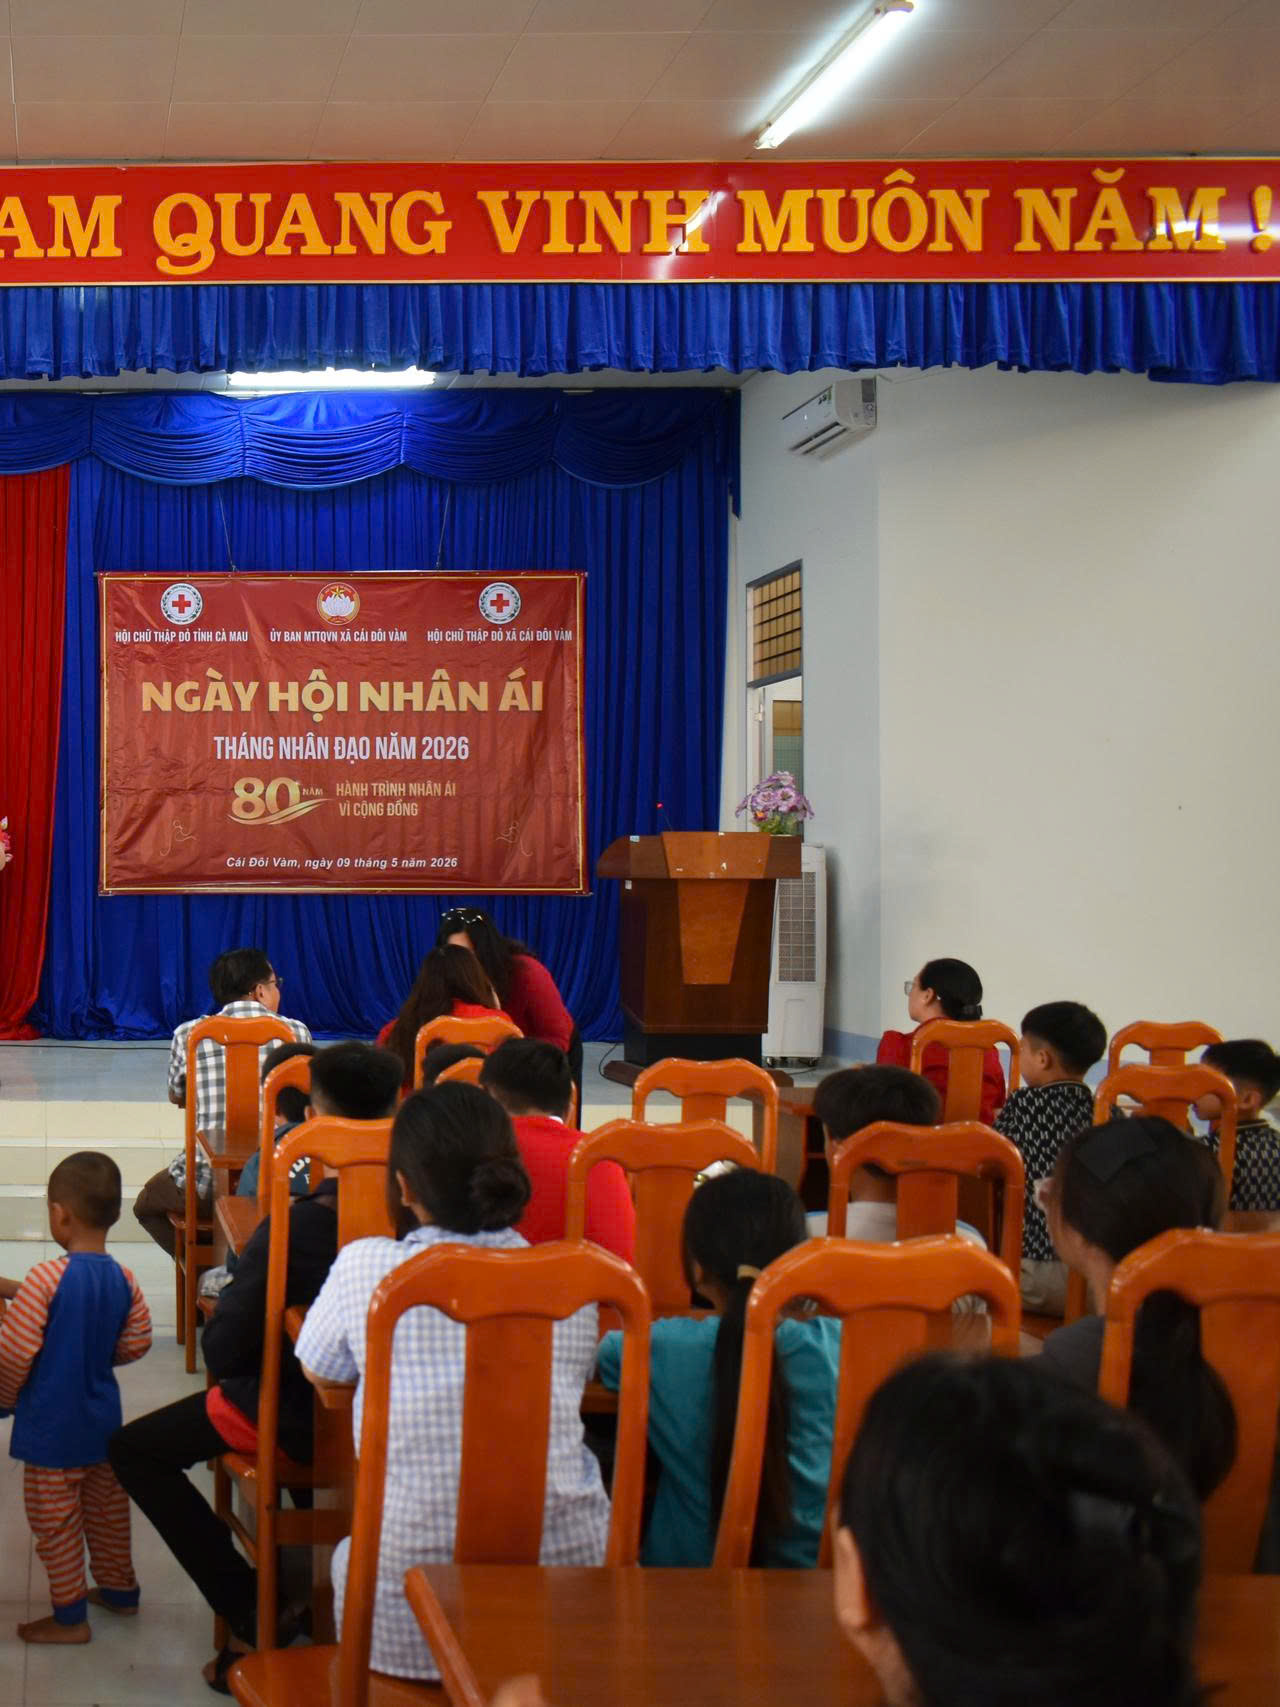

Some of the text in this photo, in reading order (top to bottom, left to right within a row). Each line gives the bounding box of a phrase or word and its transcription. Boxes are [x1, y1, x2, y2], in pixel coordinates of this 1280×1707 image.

[153, 191, 453, 275] QUANG
[477, 190, 710, 255] VINH
[735, 168, 990, 253] MUÔN
[1013, 167, 1227, 252] NĂM
[115, 627, 248, 644] HỘI CHỮ THẬP ĐỎ TỈNH CÀ MAU
[270, 627, 407, 643] ỦY BAN MTTQVN XÃ CÁI ĐÔI VÀM
[427, 628, 443, 644] HỘI
[445, 628, 464, 642] CHỮ
[466, 628, 489, 644] THẬP
[505, 628, 517, 642] XÃ
[519, 627, 534, 642] CÁI
[536, 627, 552, 642] ĐÔI
[554, 627, 573, 641] VÀM
[142, 667, 544, 723] NGÀY HỘI NHÂN ÁI
[213, 732, 470, 765] THÁNG NHÂN ĐẠO NĂM 2026
[336, 780, 456, 797] HÀNH TRÌNH NHÂN ÁI
[231, 777, 301, 819] 80
[339, 799, 418, 819] VÌ CỘNG ĐỒNG
[226, 857, 458, 872] Cái Đôi Vàm, ngày 09 tháng 5 năm 2026
